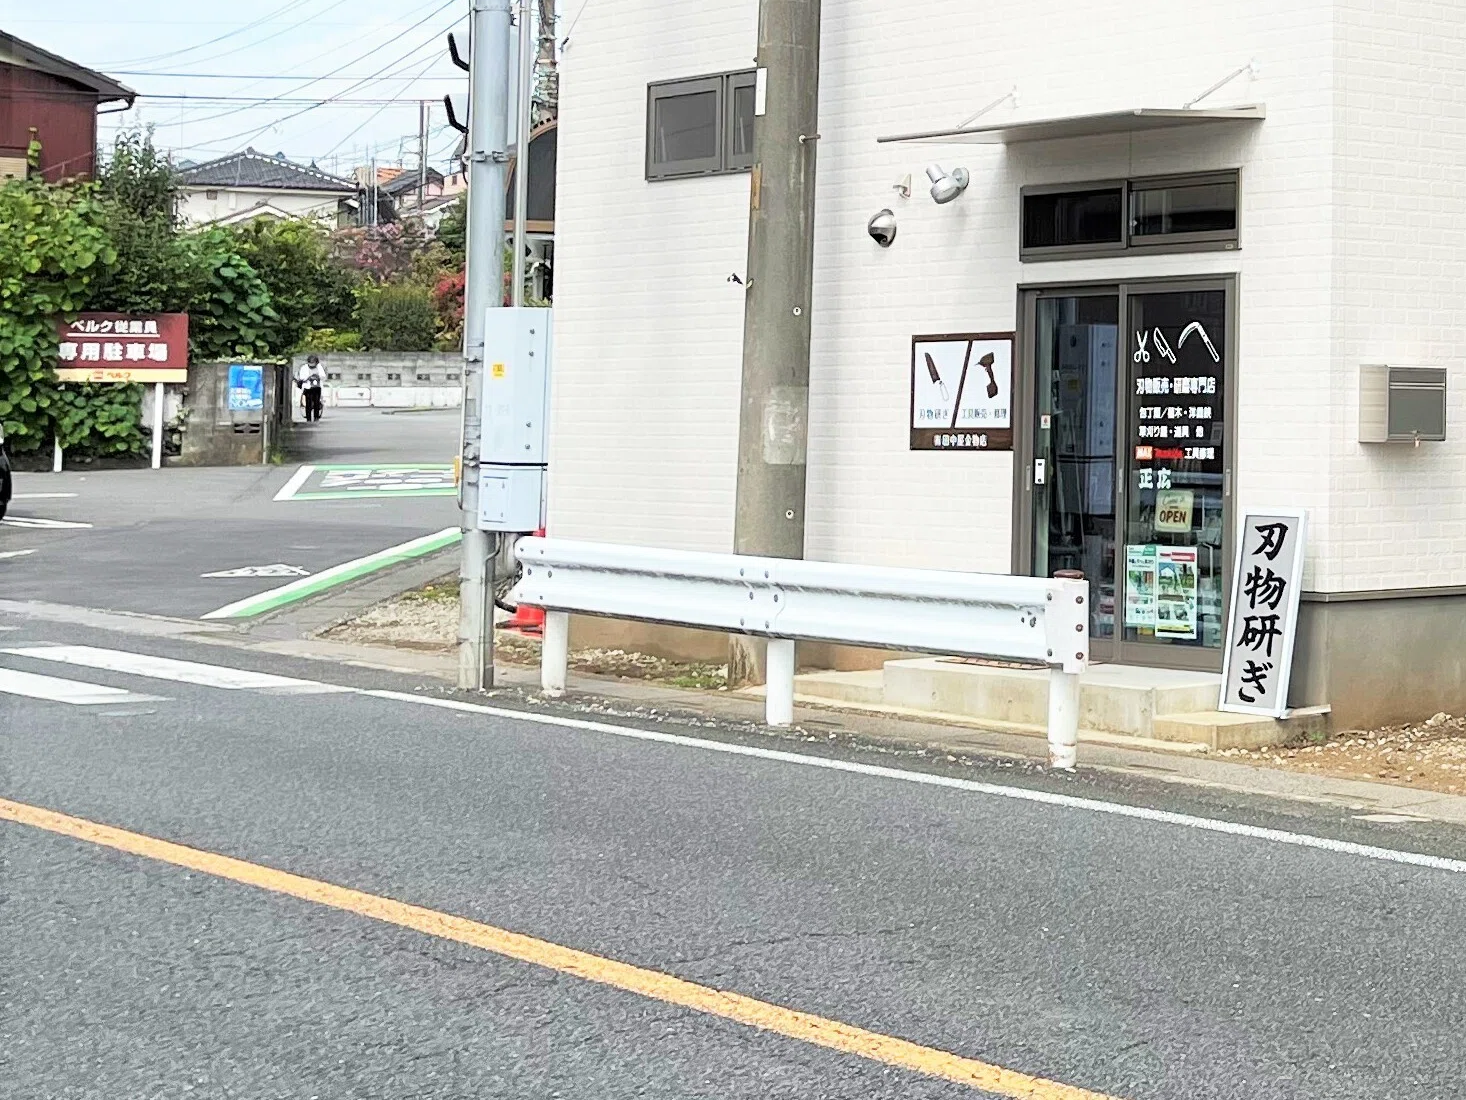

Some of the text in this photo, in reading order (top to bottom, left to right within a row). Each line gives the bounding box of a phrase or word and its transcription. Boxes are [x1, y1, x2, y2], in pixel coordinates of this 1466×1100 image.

[70, 320, 158, 334] ベルク従業員
[58, 342, 168, 362] 専用駐車場
[1159, 510, 1187, 523] OPEN
[1236, 522, 1289, 704] 刃物研ぎ
